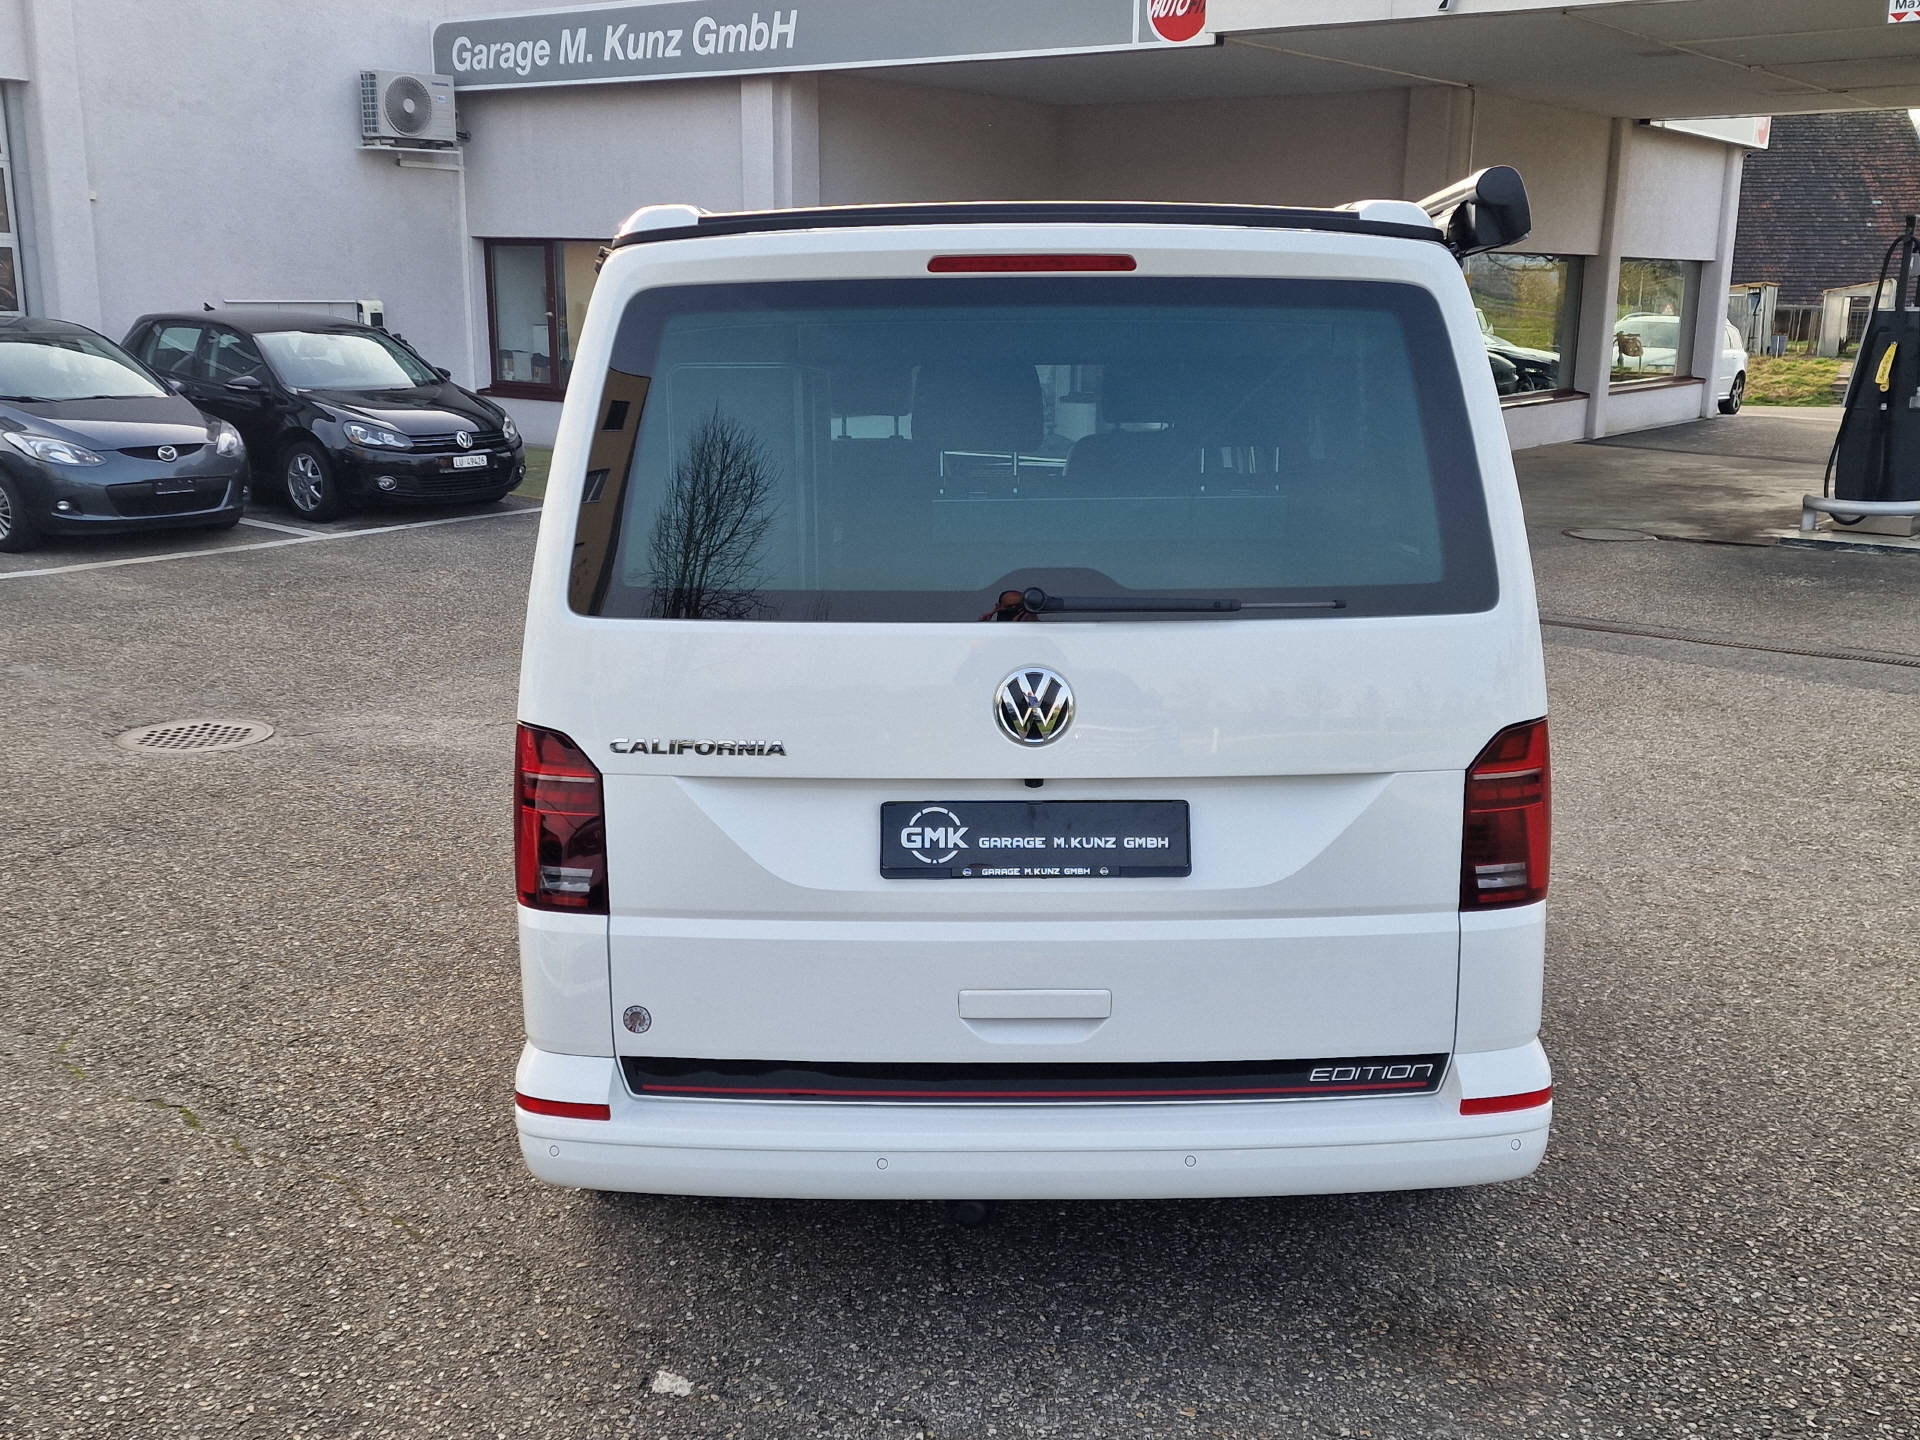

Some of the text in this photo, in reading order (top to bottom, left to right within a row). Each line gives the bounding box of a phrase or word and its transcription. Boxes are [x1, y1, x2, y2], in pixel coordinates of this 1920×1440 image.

[451, 9, 798, 76] Garage M. Kunz GmbH
[609, 737, 787, 756] CALIFORNIA
[900, 826, 970, 849] GMK
[978, 836, 1047, 849] GARAGE
[1123, 836, 1170, 849] GMBH
[981, 868, 1021, 876] GARAGE
[1063, 867, 1091, 875] GMBH
[1309, 1063, 1434, 1082] EDITION
